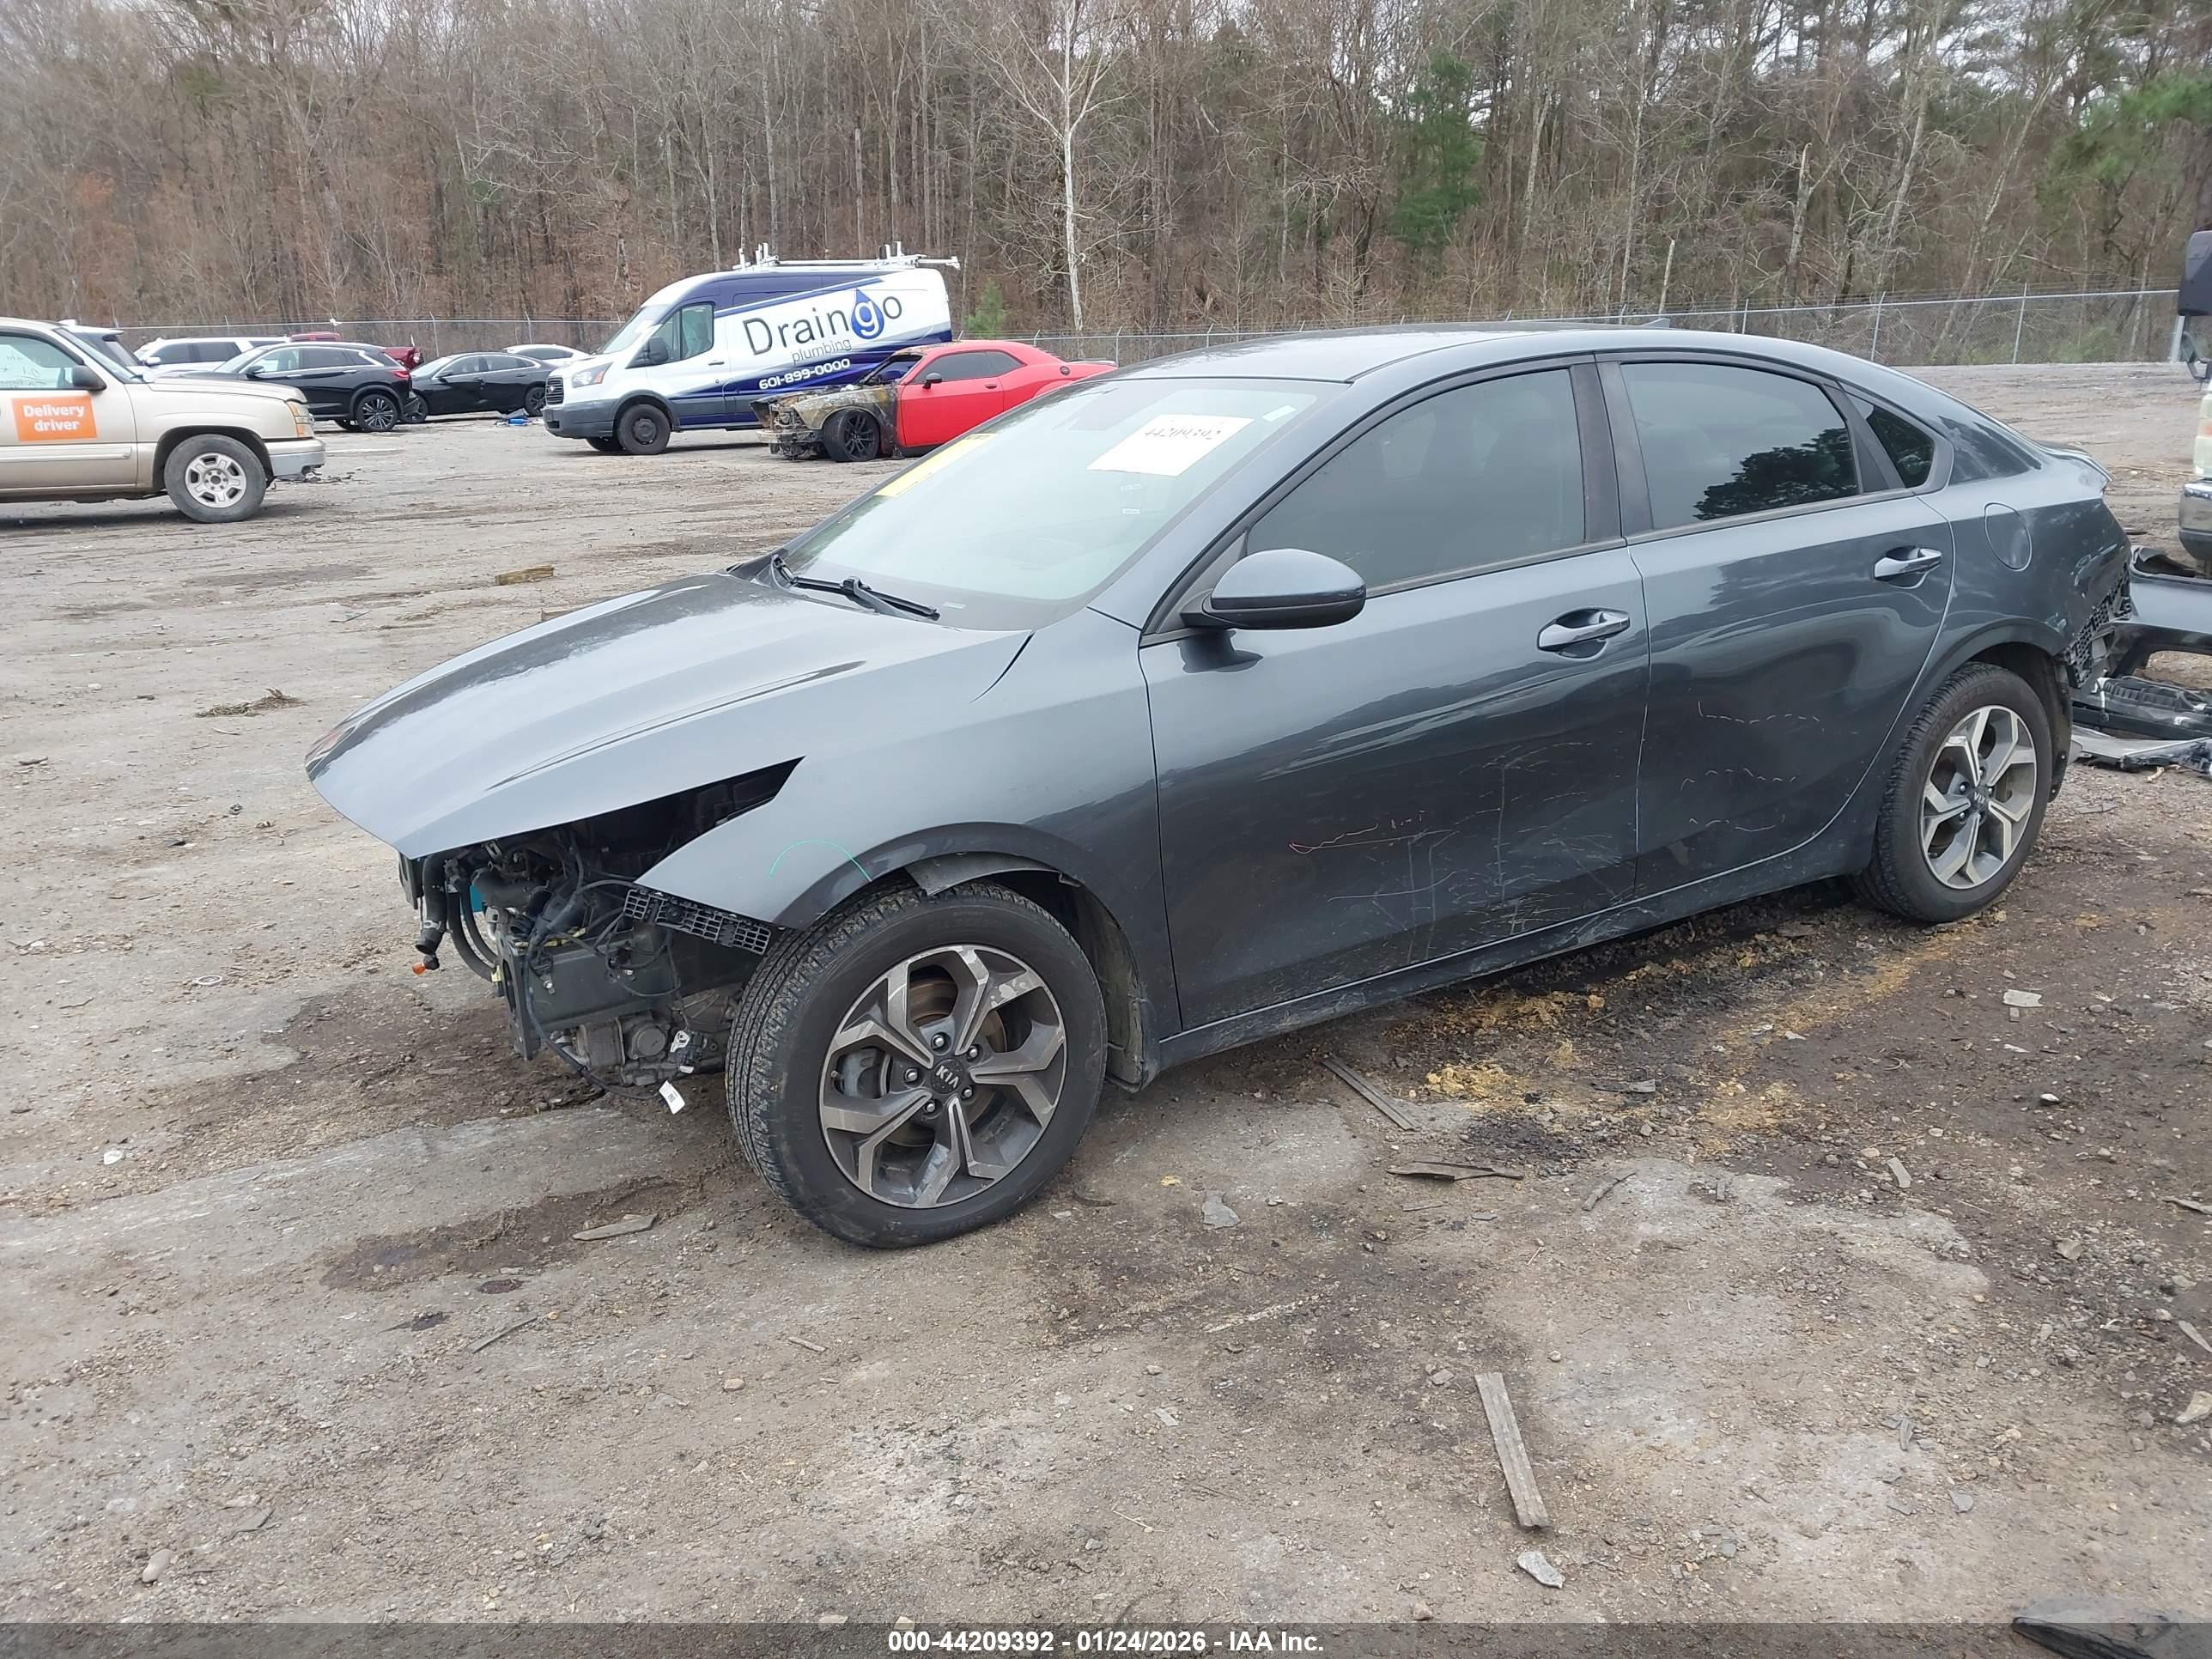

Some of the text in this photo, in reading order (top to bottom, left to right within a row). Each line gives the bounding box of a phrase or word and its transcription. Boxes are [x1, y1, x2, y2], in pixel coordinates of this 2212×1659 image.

[742, 295, 902, 356] Draingo
[792, 338, 853, 366] plumbing
[758, 358, 851, 389] 601-899-0000
[22, 404, 85, 418] Delivery
[34, 419, 80, 431] driver
[936, 1066, 959, 1088] KIA
